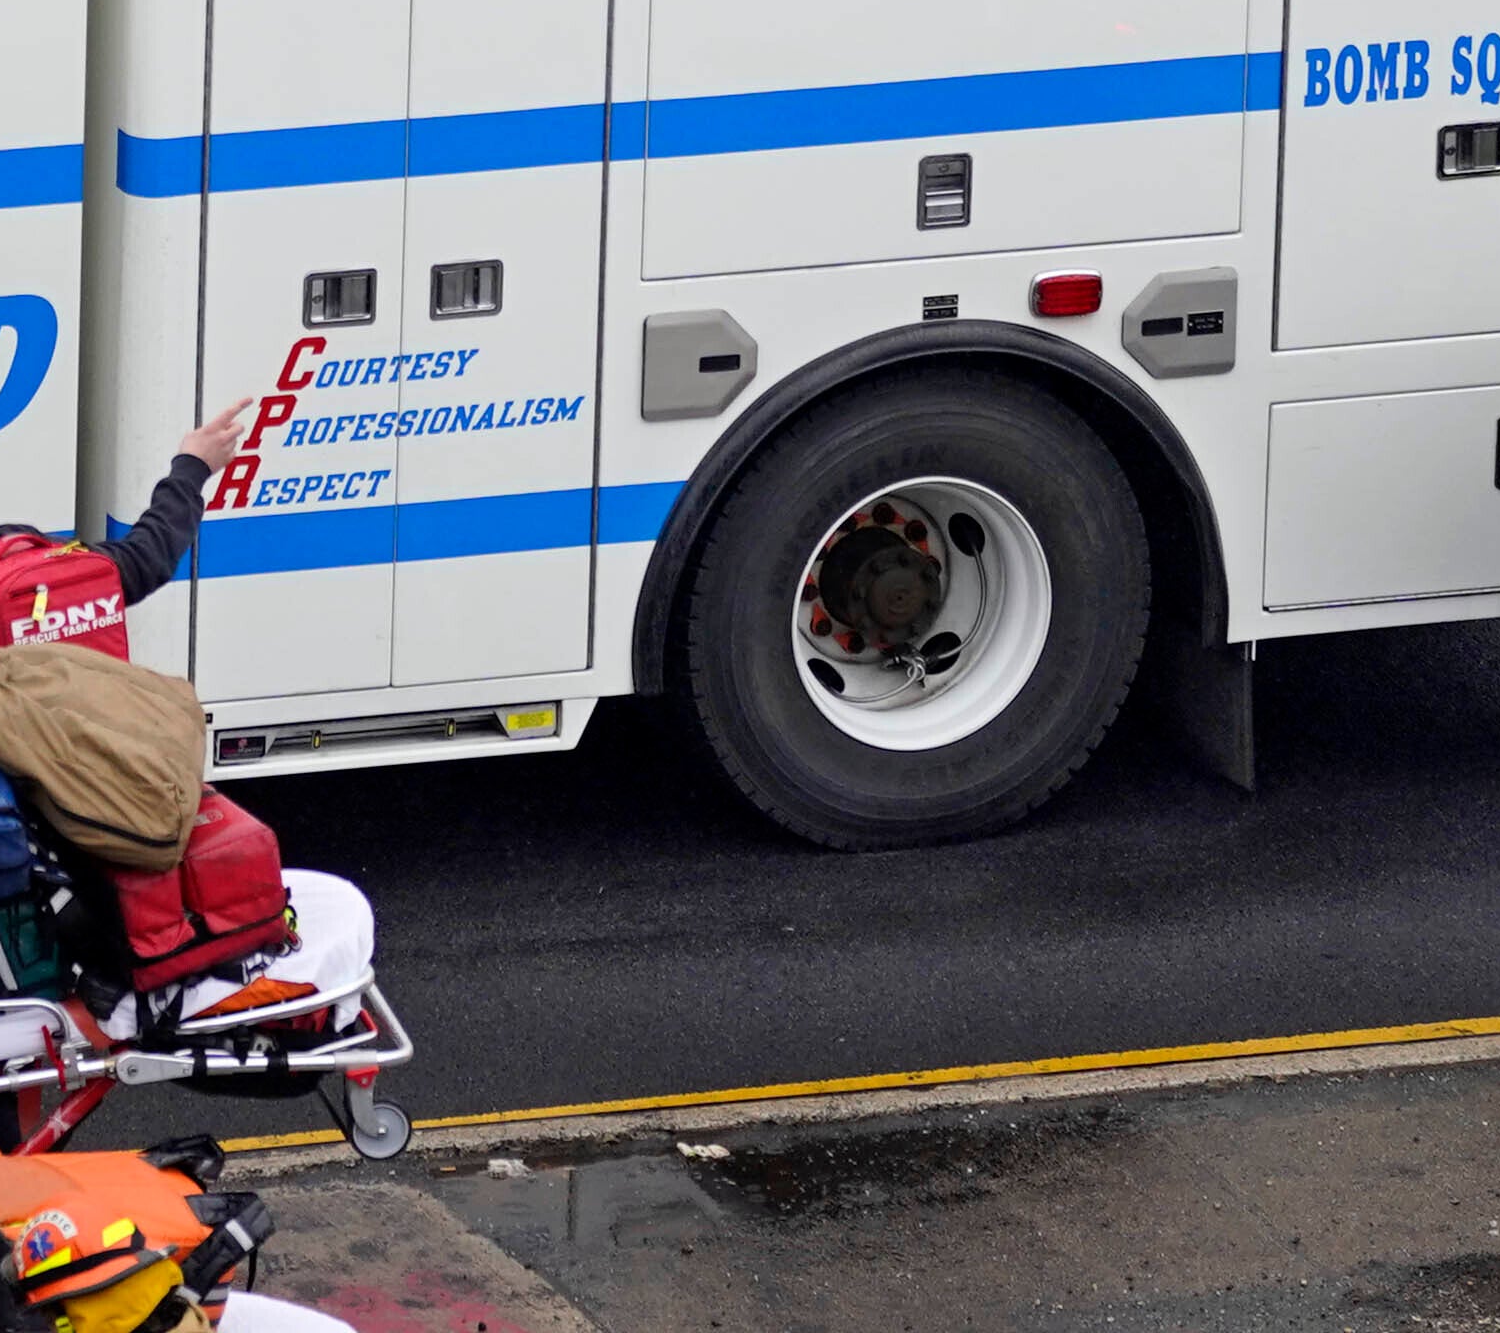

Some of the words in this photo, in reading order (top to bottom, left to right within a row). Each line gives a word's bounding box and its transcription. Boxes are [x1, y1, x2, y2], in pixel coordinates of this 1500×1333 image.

[1304, 41, 1430, 108] BOMB
[276, 336, 479, 391] COURTESY
[242, 394, 585, 451] PROFESSIONALISM
[206, 454, 391, 512] RESPECT
[11, 593, 121, 639] FDNY
